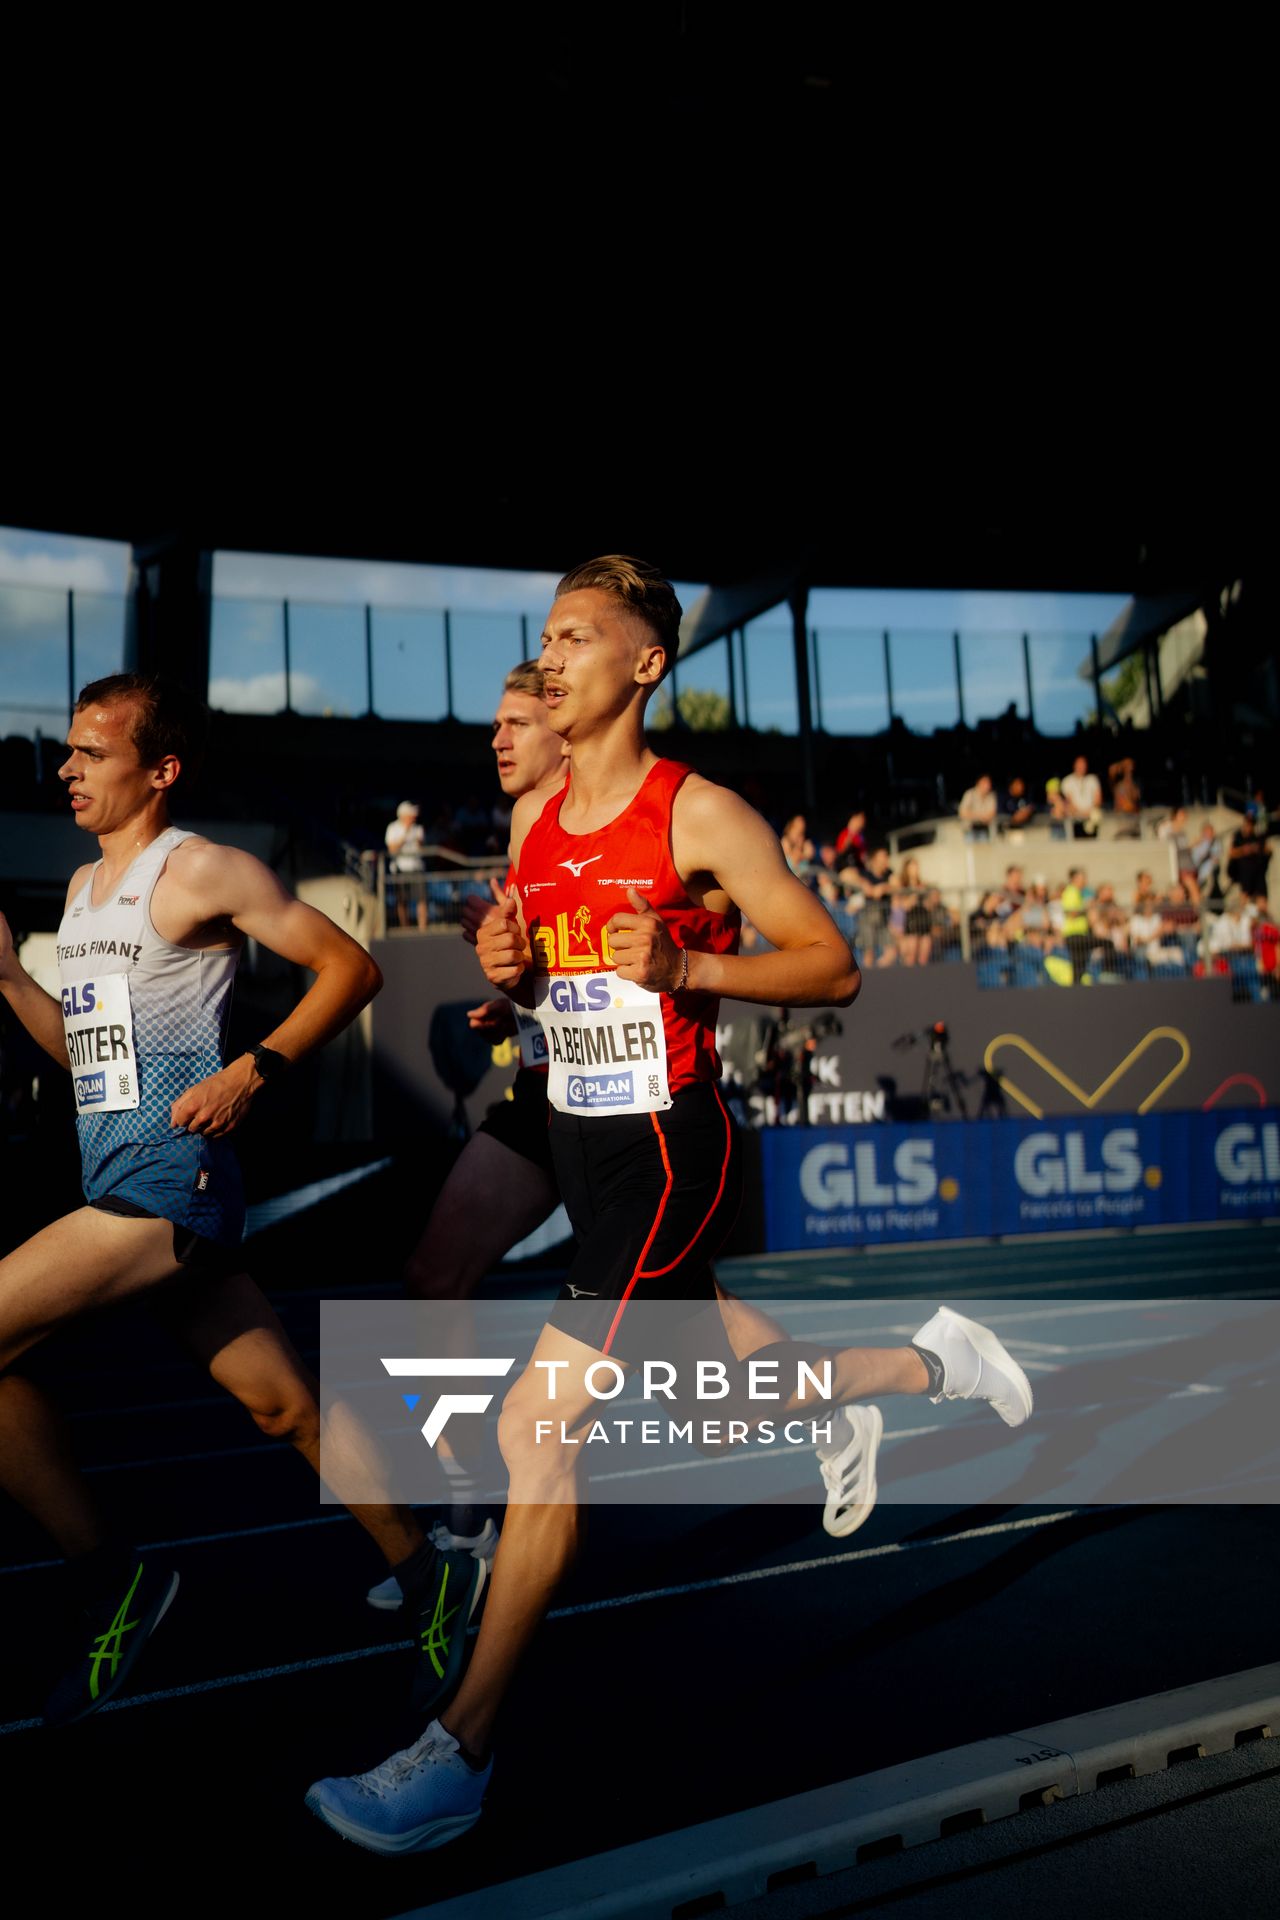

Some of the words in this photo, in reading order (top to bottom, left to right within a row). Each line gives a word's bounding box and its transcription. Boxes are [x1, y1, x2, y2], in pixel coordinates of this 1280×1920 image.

[60, 943, 87, 960] TELIS
[89, 940, 142, 962] FINANZ
[67, 1024, 129, 1067] RITTER
[550, 1021, 659, 1065] A.BEIMLER
[118, 1074, 130, 1095] 369
[585, 1079, 631, 1096] PLAN
[647, 1074, 660, 1097] 582
